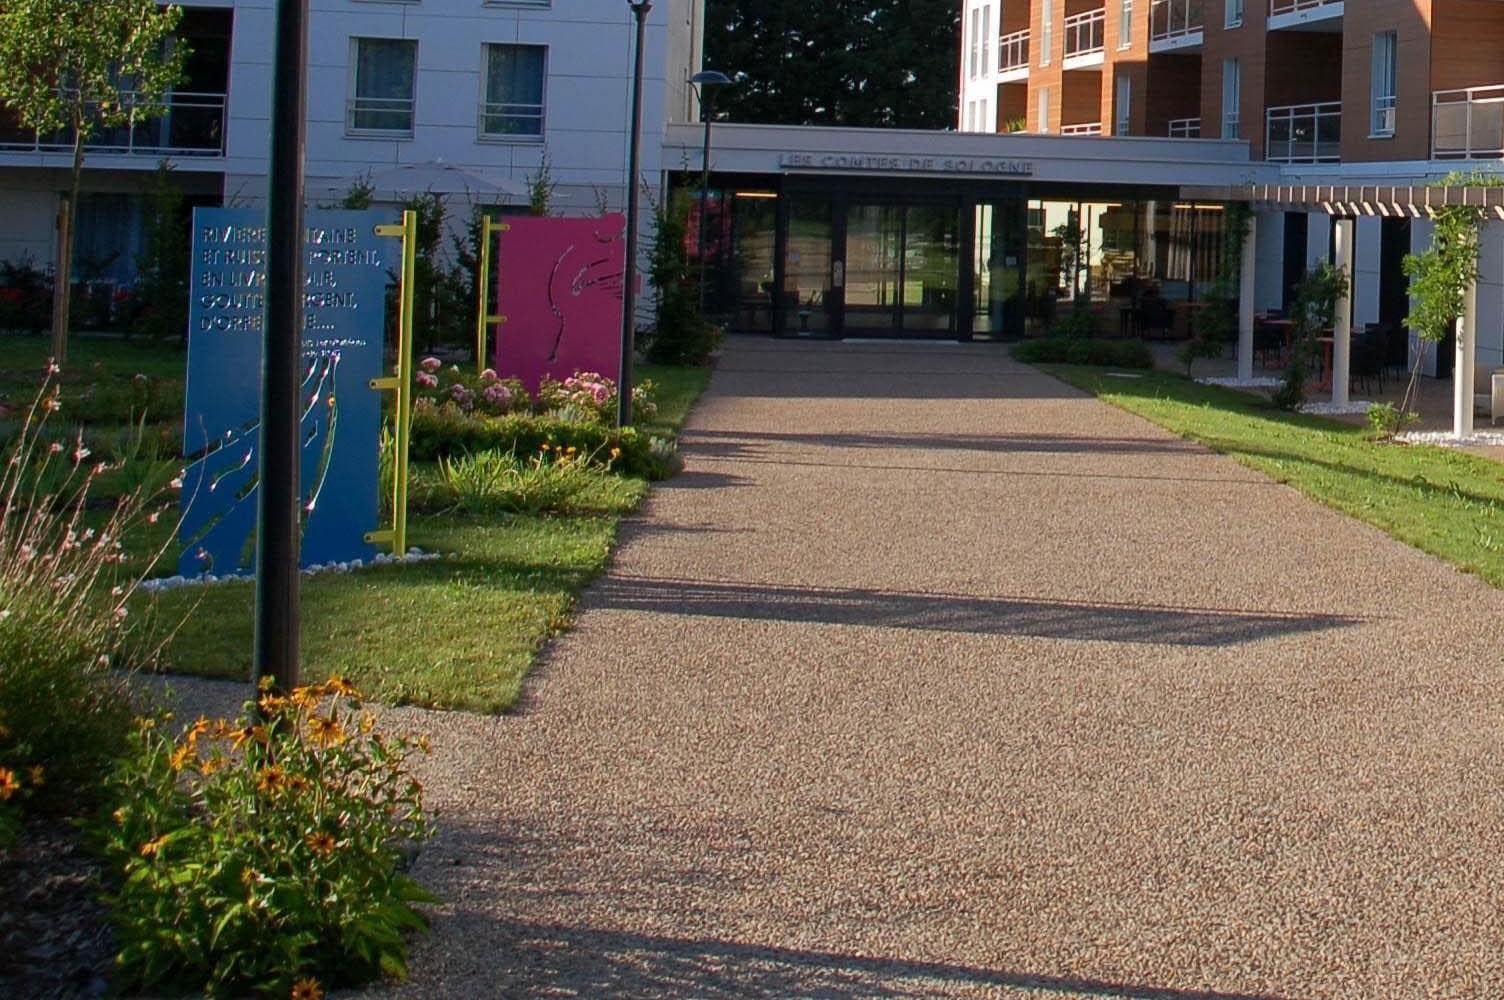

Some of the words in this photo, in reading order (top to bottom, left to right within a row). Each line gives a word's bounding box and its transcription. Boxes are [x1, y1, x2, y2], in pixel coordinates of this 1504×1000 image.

[778, 153, 816, 167] LES
[821, 154, 899, 169] COMTES
[909, 158, 935, 171] DE
[943, 159, 1033, 174] SOLOGNE
[203, 249, 220, 265] ET
[202, 271, 224, 287] EN
